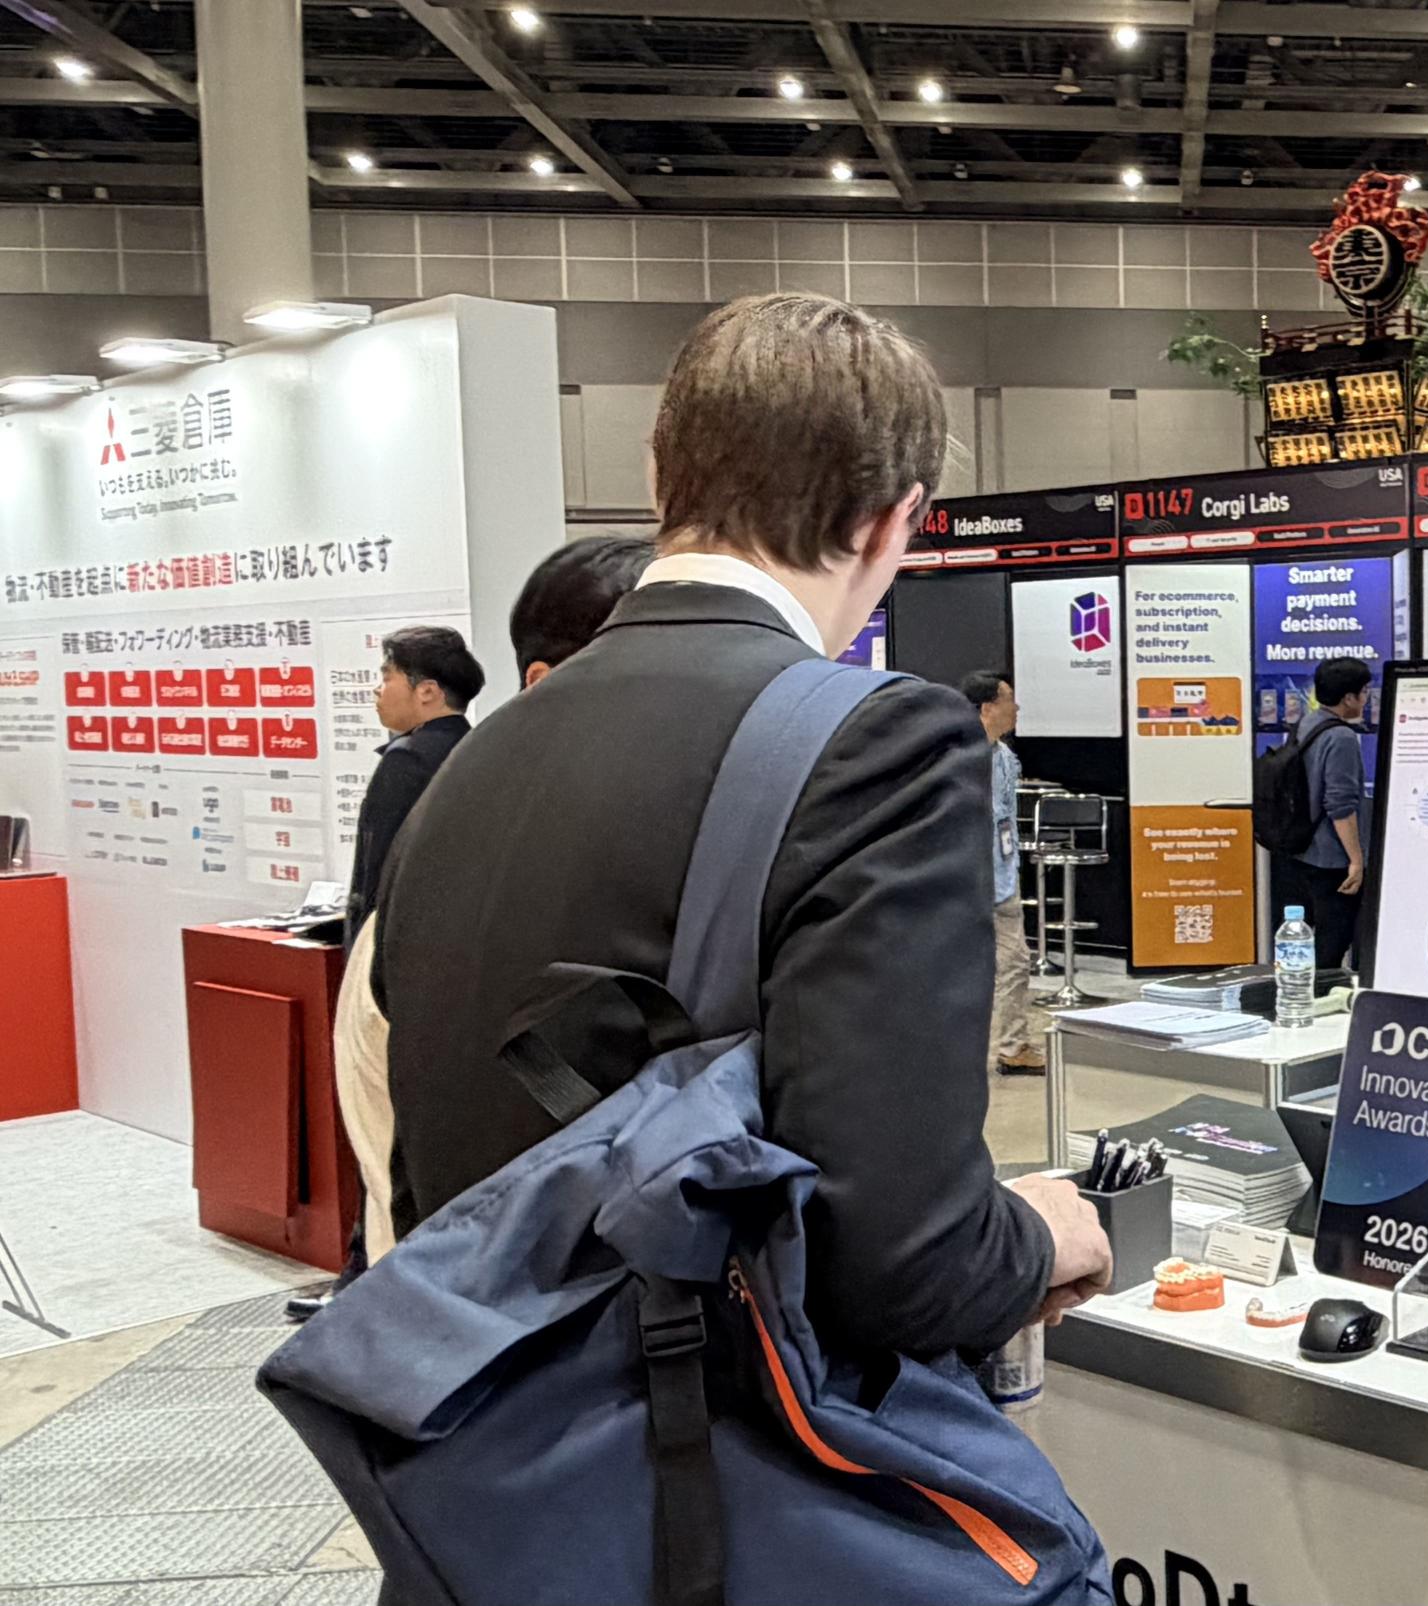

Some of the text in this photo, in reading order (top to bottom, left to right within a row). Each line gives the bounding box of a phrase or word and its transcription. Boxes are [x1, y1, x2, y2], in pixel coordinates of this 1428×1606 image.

[129, 389, 232, 457] 三菱倉庫
[1379, 468, 1404, 482] USA
[1095, 494, 1114, 507] USA
[1201, 497, 1246, 519] Corgi
[1250, 492, 1291, 514] Labs
[953, 515, 1024, 537] IdeaBoxes
[1288, 566, 1354, 585] Smarter
[1135, 591, 1239, 603] For ecommerce,
[1286, 590, 1357, 612] payment
[1135, 606, 1222, 619] subscription,
[1135, 621, 1209, 632] and instant
[1280, 614, 1363, 633] decisions.
[1135, 637, 1190, 650] delivery
[1265, 643, 1380, 661] More revenue.
[1135, 652, 1216, 664] businesses.
[1362, 1250, 1413, 1274] Honore
